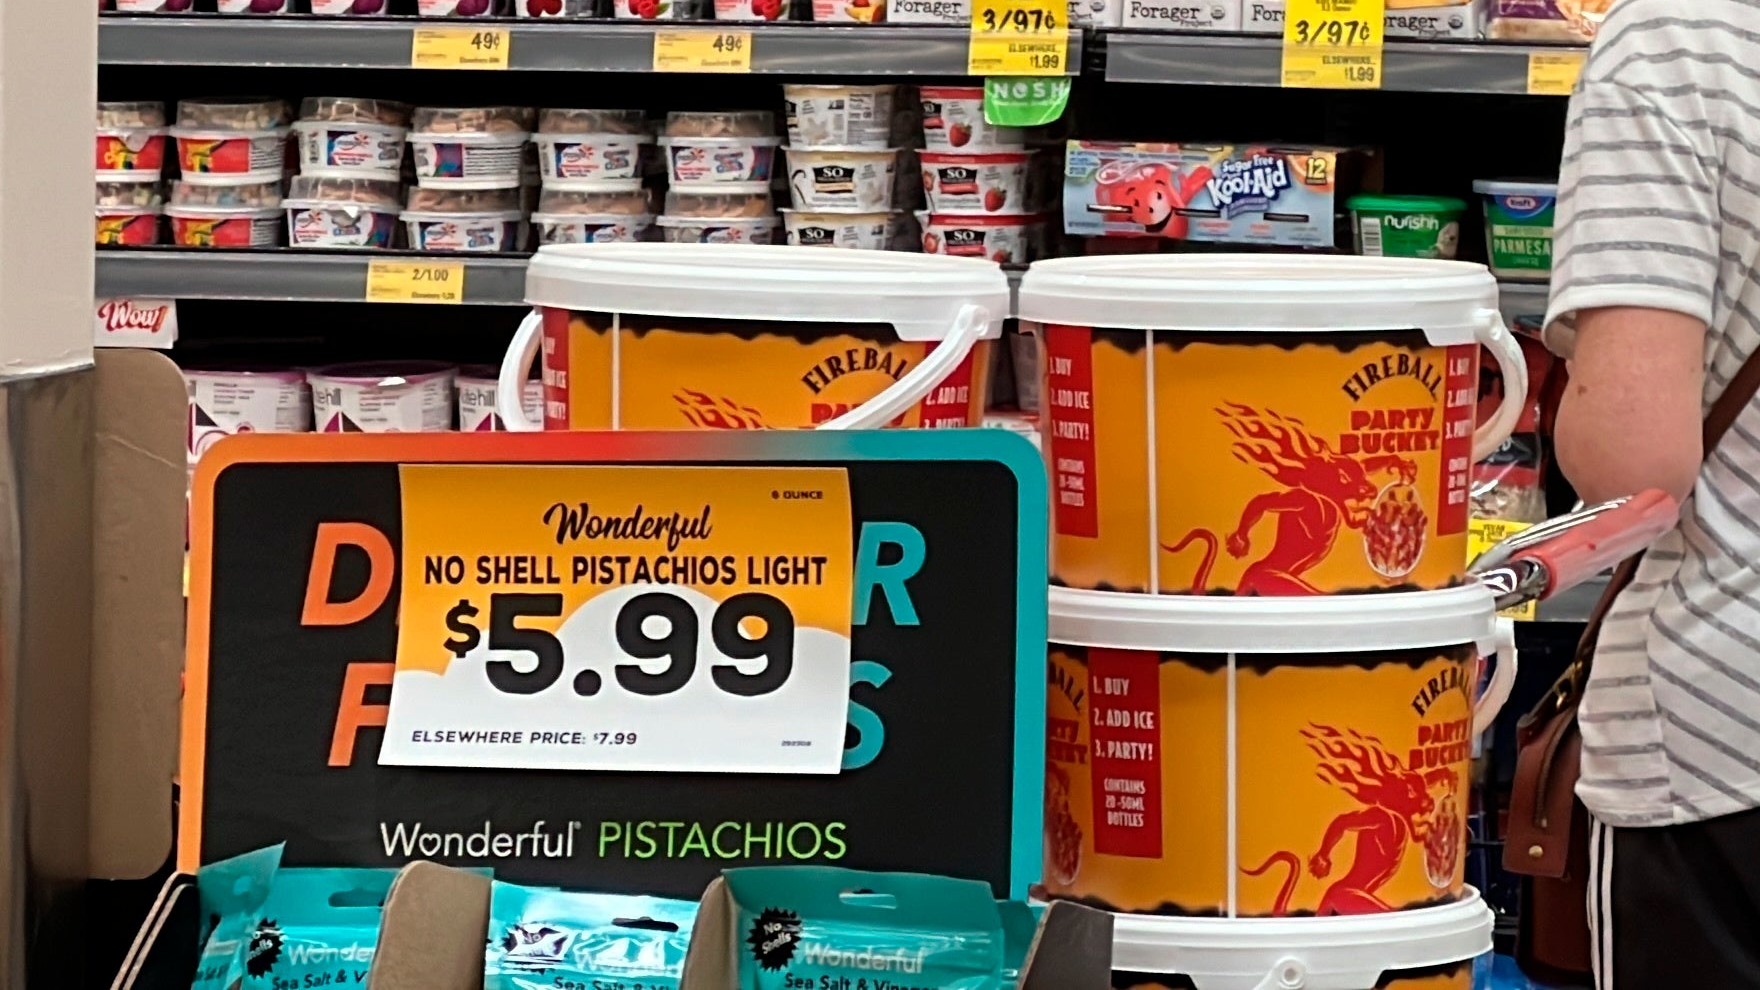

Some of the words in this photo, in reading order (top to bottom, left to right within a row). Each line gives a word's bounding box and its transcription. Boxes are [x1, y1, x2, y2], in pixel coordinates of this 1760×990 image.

[983, 9, 1055, 33] 3/97¢
[1130, 2, 1200, 23] Forager
[471, 31, 500, 50] 49¢
[1295, 20, 1370, 46] 3/97¢
[713, 35, 742, 52] 49¢
[994, 83, 1065, 99] NOSH
[823, 168, 844, 178] SO
[947, 168, 966, 179] SO
[1222, 159, 1250, 173] Sugar
[1253, 155, 1274, 167] Free
[1306, 158, 1326, 177] 12
[1207, 161, 1288, 207] Kool-Aid
[806, 228, 824, 239] SO
[954, 230, 974, 240] SO
[1494, 237, 1552, 257] PARMESA
[412, 268, 449, 284] 2/1.00
[101, 301, 168, 332] Wow!
[801, 347, 908, 394] FIREBAL
[1341, 353, 1442, 402] FIREBALL
[1351, 407, 1435, 431] PARTY
[1059, 421, 1090, 441] PARTY!
[1340, 430, 1440, 455] BUCKET
[783, 490, 824, 500] OUNCE
[543, 502, 713, 552] Wonderful
[424, 556, 465, 585] NO
[476, 556, 560, 585] SHELL
[572, 556, 741, 585] PISTACHIOS
[748, 556, 828, 586] LIGHT
[443, 592, 796, 697] $5.99
[1093, 676, 1102, 694] 1.
[1104, 677, 1130, 696] BUY
[1094, 708, 1105, 727] 2.
[1106, 709, 1131, 728] ADD
[1134, 711, 1154, 730] ICE
[411, 730, 523, 746] ELSEWHERE
[530, 731, 587, 746] PRICE:
[593, 732, 638, 746] $7.99
[1095, 739, 1106, 758] 3.
[1107, 741, 1153, 761] PARTY!
[1104, 778, 1146, 794] CONTAINS
[1107, 811, 1144, 827] BOTTLES
[380, 821, 574, 860] Wonderful
[598, 822, 847, 860] PISTACHIOS
[763, 922, 782, 935] No
[804, 942, 925, 974] Wonderful
[272, 974, 299, 990] Sea
[304, 970, 332, 989] Salt
[335, 973, 348, 986] &
[784, 973, 806, 989] Sea
[813, 974, 852, 990] Salt
